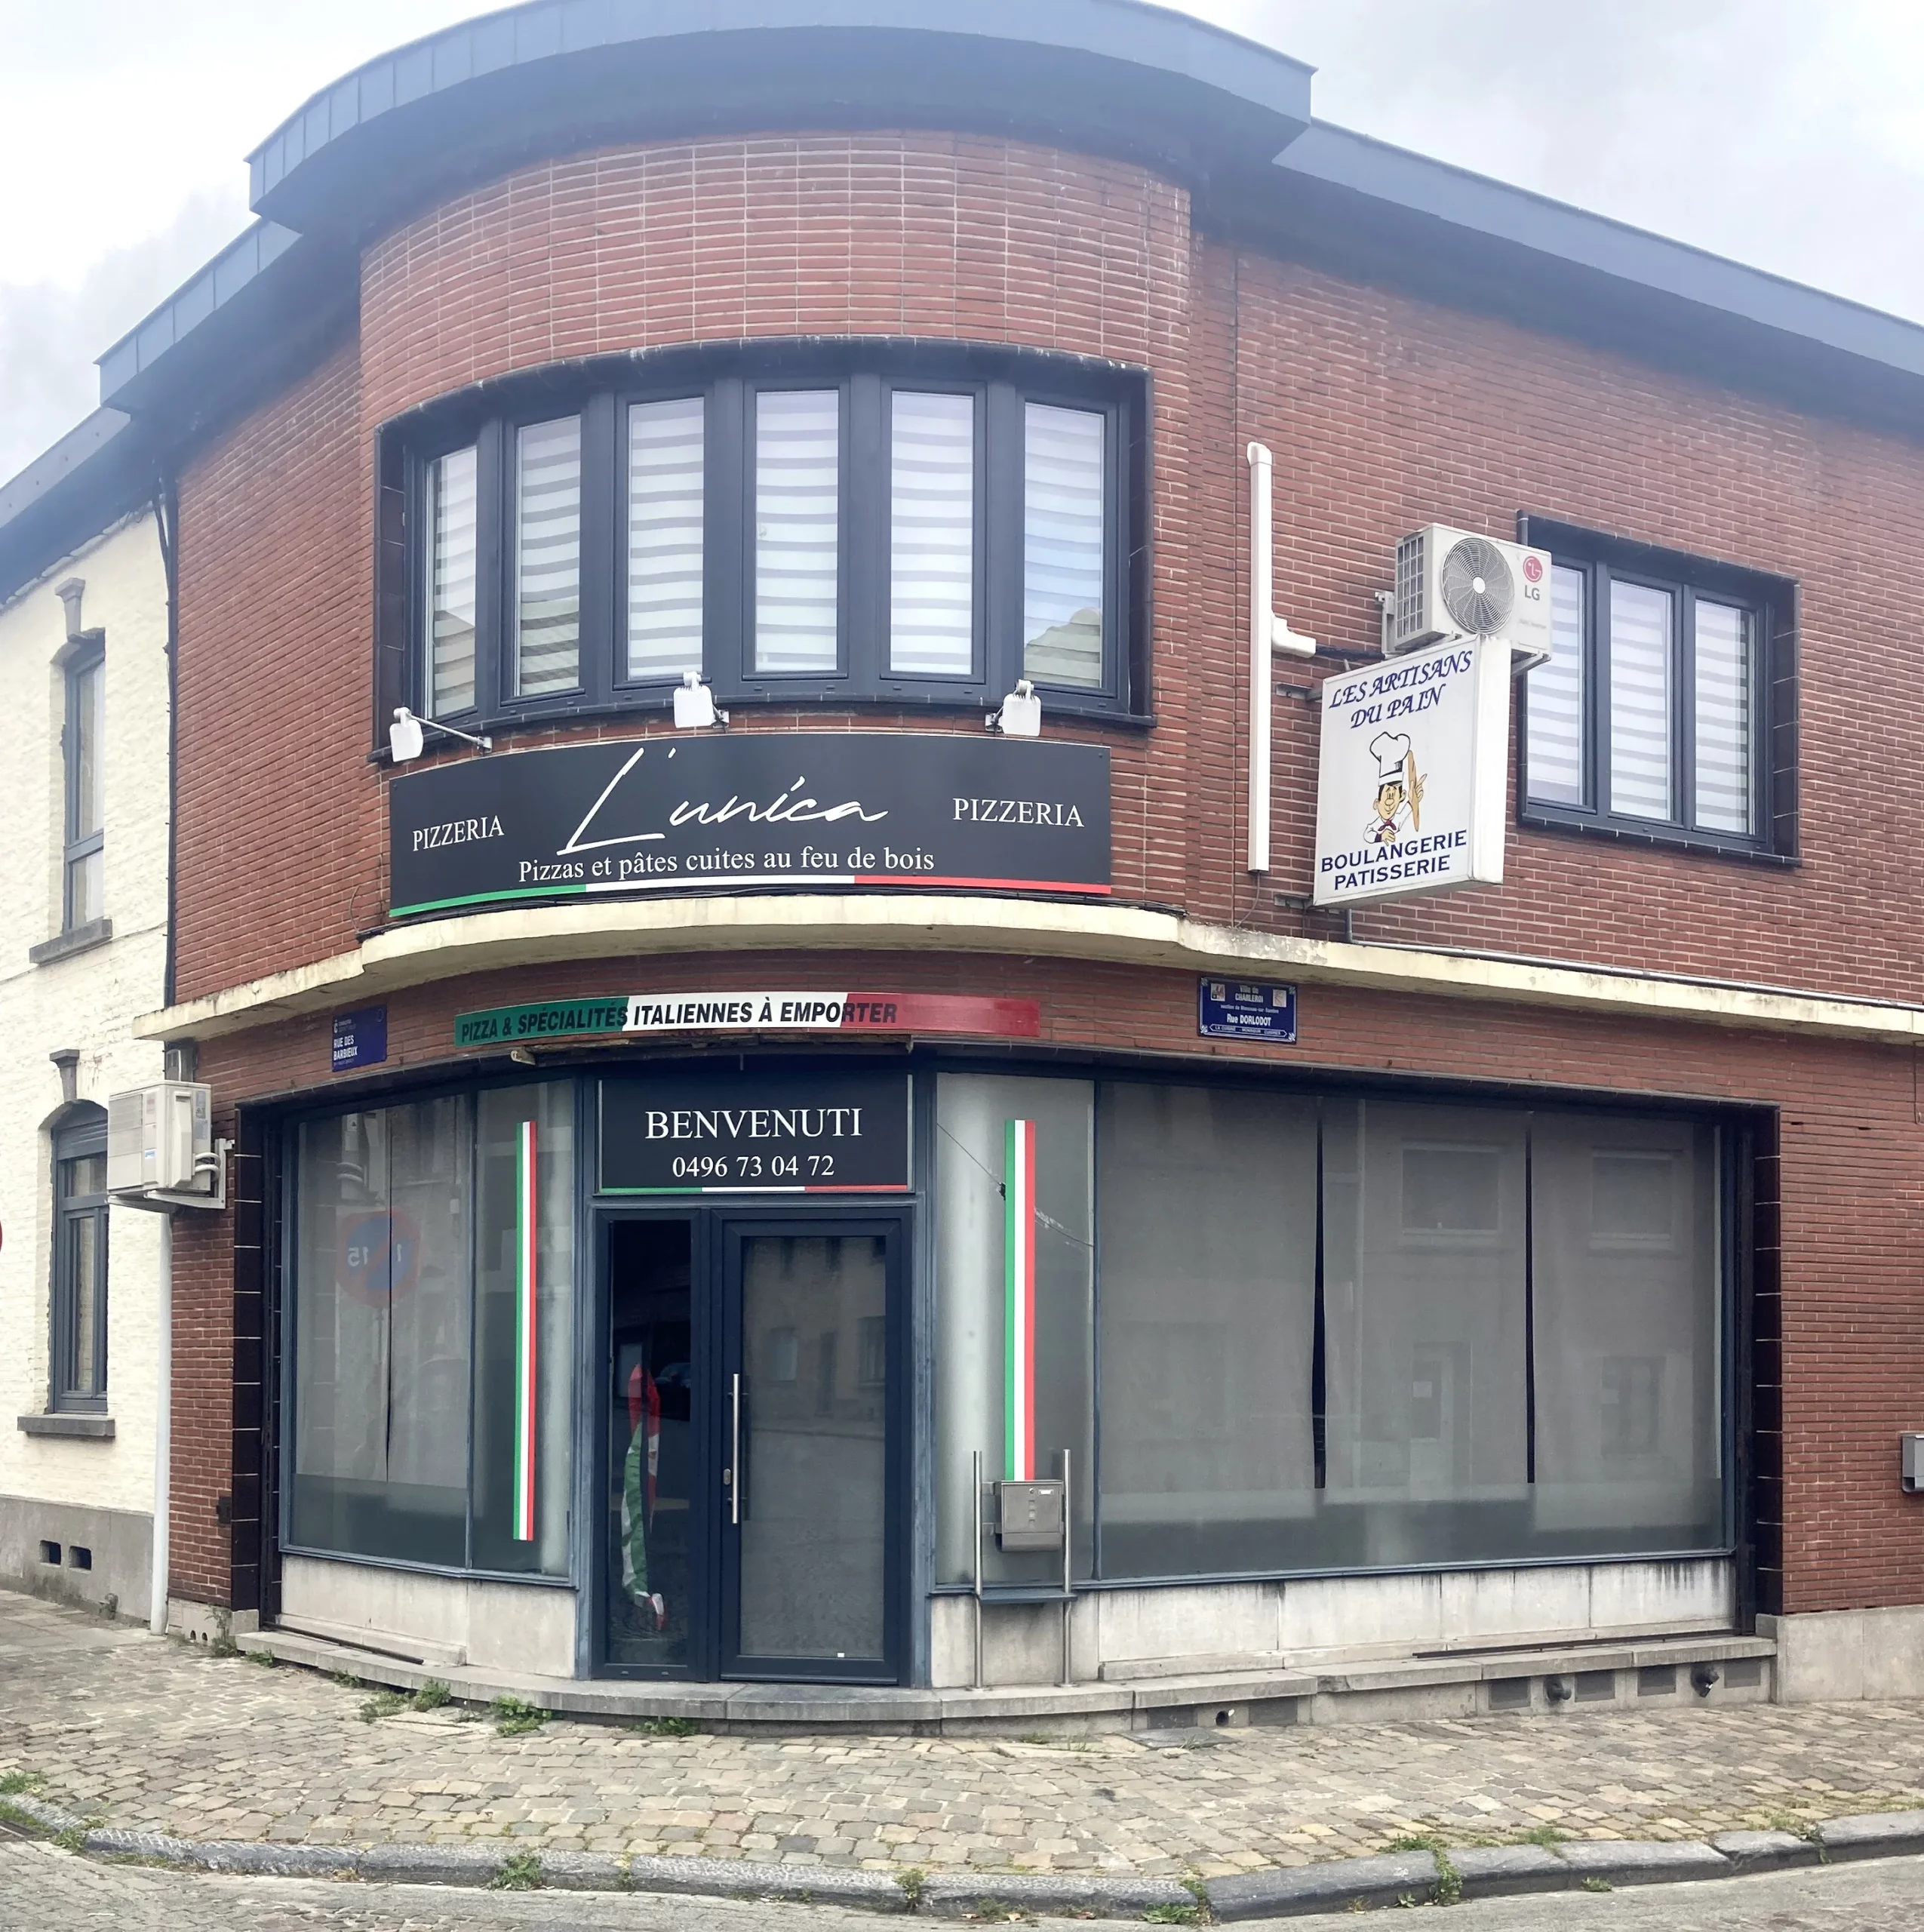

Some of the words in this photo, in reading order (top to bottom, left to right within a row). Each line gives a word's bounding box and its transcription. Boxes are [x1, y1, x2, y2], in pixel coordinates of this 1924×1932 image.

[1524, 584, 1540, 601] LG
[1329, 681, 1368, 709] LES
[1369, 651, 1473, 698] ARTISANS
[1350, 705, 1382, 729] DU
[1387, 684, 1446, 719] PAIN
[952, 798, 1085, 827] PIZZERIA
[412, 815, 505, 852] PIZZERIA
[1320, 829, 1467, 873] BOULANGERIE
[518, 859, 584, 882] Pizzas
[592, 857, 613, 877] et
[619, 851, 678, 881] pâtes
[686, 847, 755, 872] cuites
[764, 853, 792, 869] au
[801, 845, 839, 869] feu
[847, 846, 876, 869] de
[883, 846, 935, 870] bois
[1334, 854, 1450, 891] PATISSERIE
[462, 1018, 497, 1043] PIZZA
[503, 1017, 512, 1035] &
[518, 1002, 629, 1035] SPÉCIALITÉS
[634, 1002, 752, 1026] ITALIENNES
[758, 997, 773, 1022] À
[779, 1001, 898, 1023] EMPORTER
[1227, 1014, 1238, 1023] Rue
[1240, 1014, 1271, 1026] DORLODOT
[644, 1108, 862, 1139] BENVENUTI
[672, 1156, 728, 1177] 0496
[736, 1156, 762, 1177] 73
[771, 1155, 799, 1177] 04
[807, 1155, 834, 1176] 72
